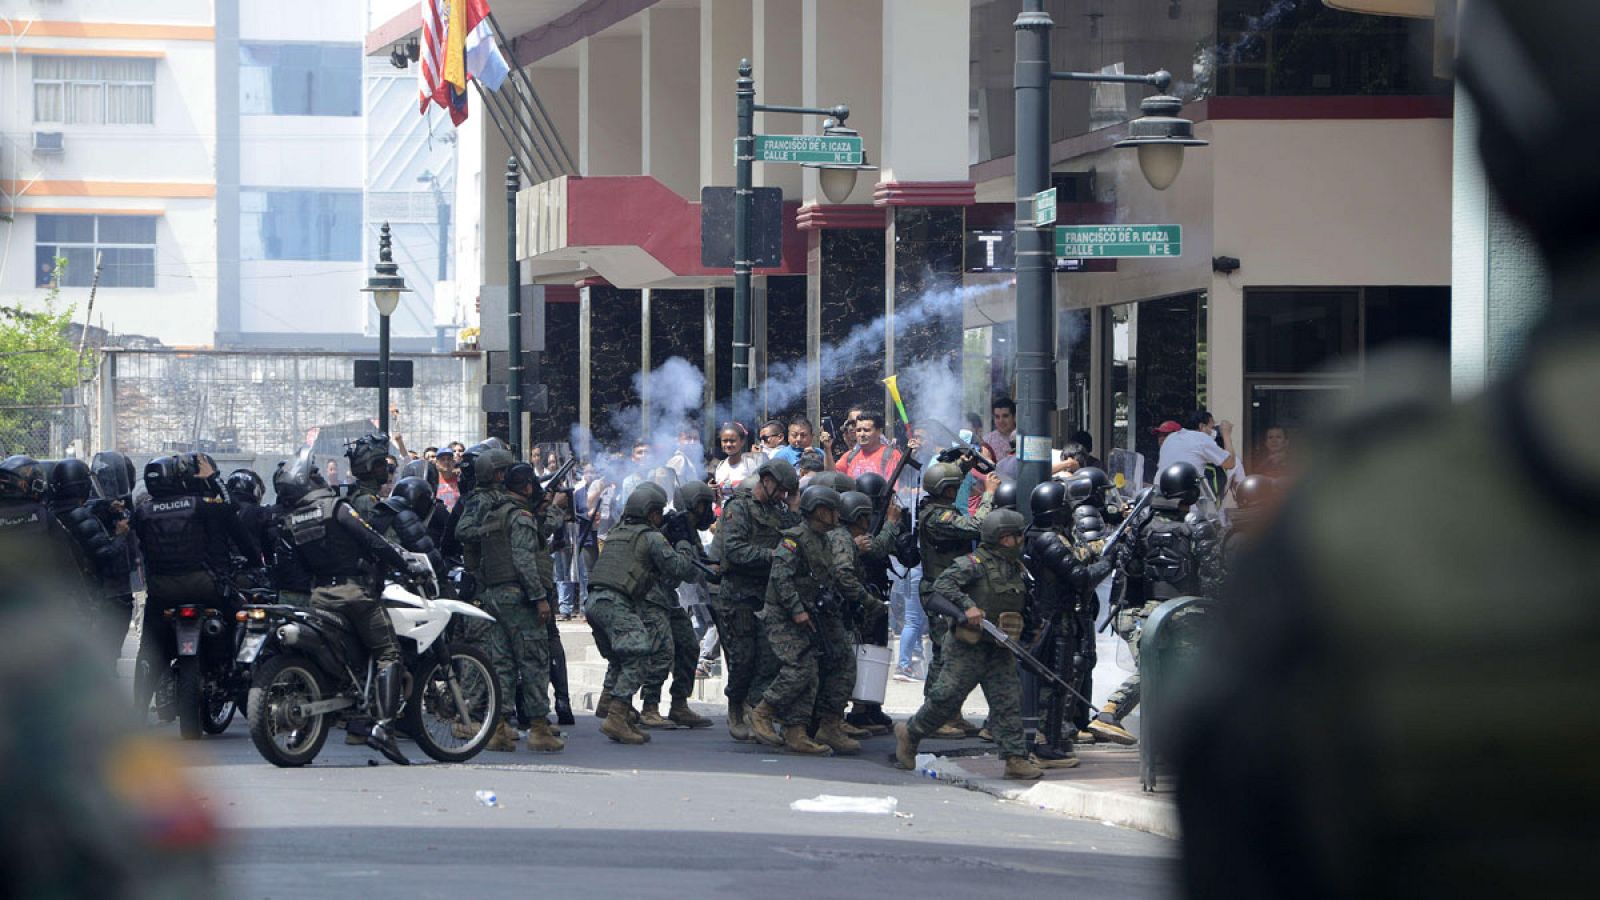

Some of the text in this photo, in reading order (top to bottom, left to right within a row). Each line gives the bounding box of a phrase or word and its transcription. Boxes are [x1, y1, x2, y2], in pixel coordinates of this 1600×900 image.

[764, 140, 852, 152] FRANCISCO DE P. ICAZA
[763, 151, 788, 160] CALLE
[1065, 231, 1116, 243] FRANCISCO
[1119, 231, 1130, 242] DE
[1142, 231, 1169, 242] ICAZA
[1065, 244, 1104, 255] CALLE 1
[153, 499, 190, 512] POLICIA
